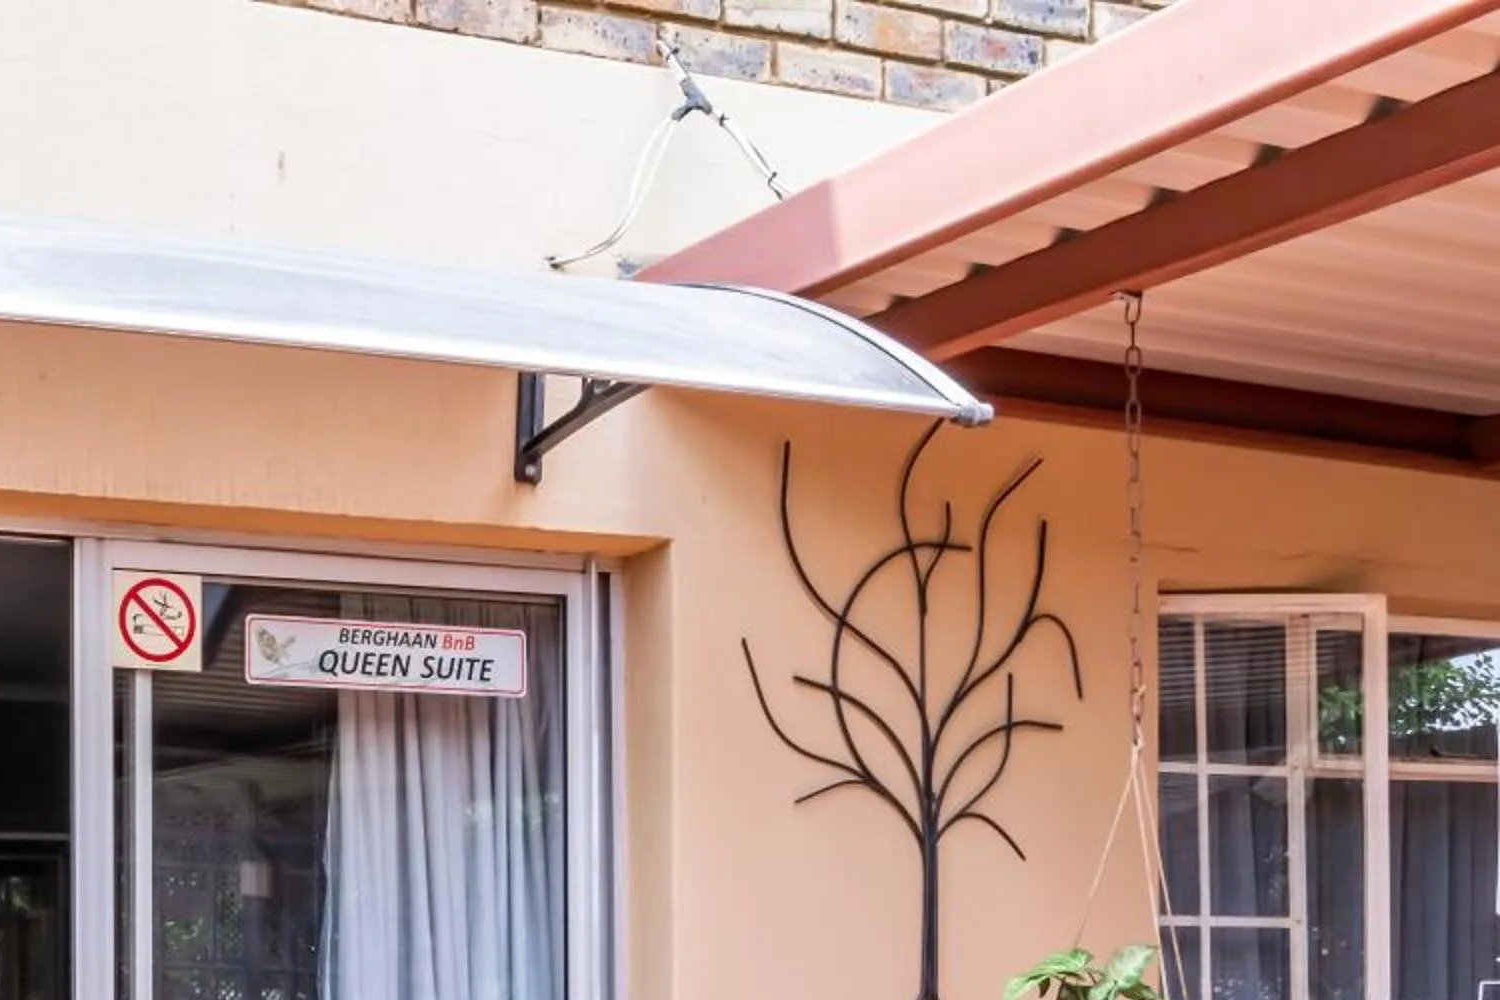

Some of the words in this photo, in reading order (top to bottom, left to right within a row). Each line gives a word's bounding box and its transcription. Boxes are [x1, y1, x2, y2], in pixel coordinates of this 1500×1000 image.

[339, 627, 438, 649] BERGHAAN
[442, 633, 475, 651] BnB
[319, 649, 411, 677] QUEEN
[420, 655, 494, 682] SUITE
